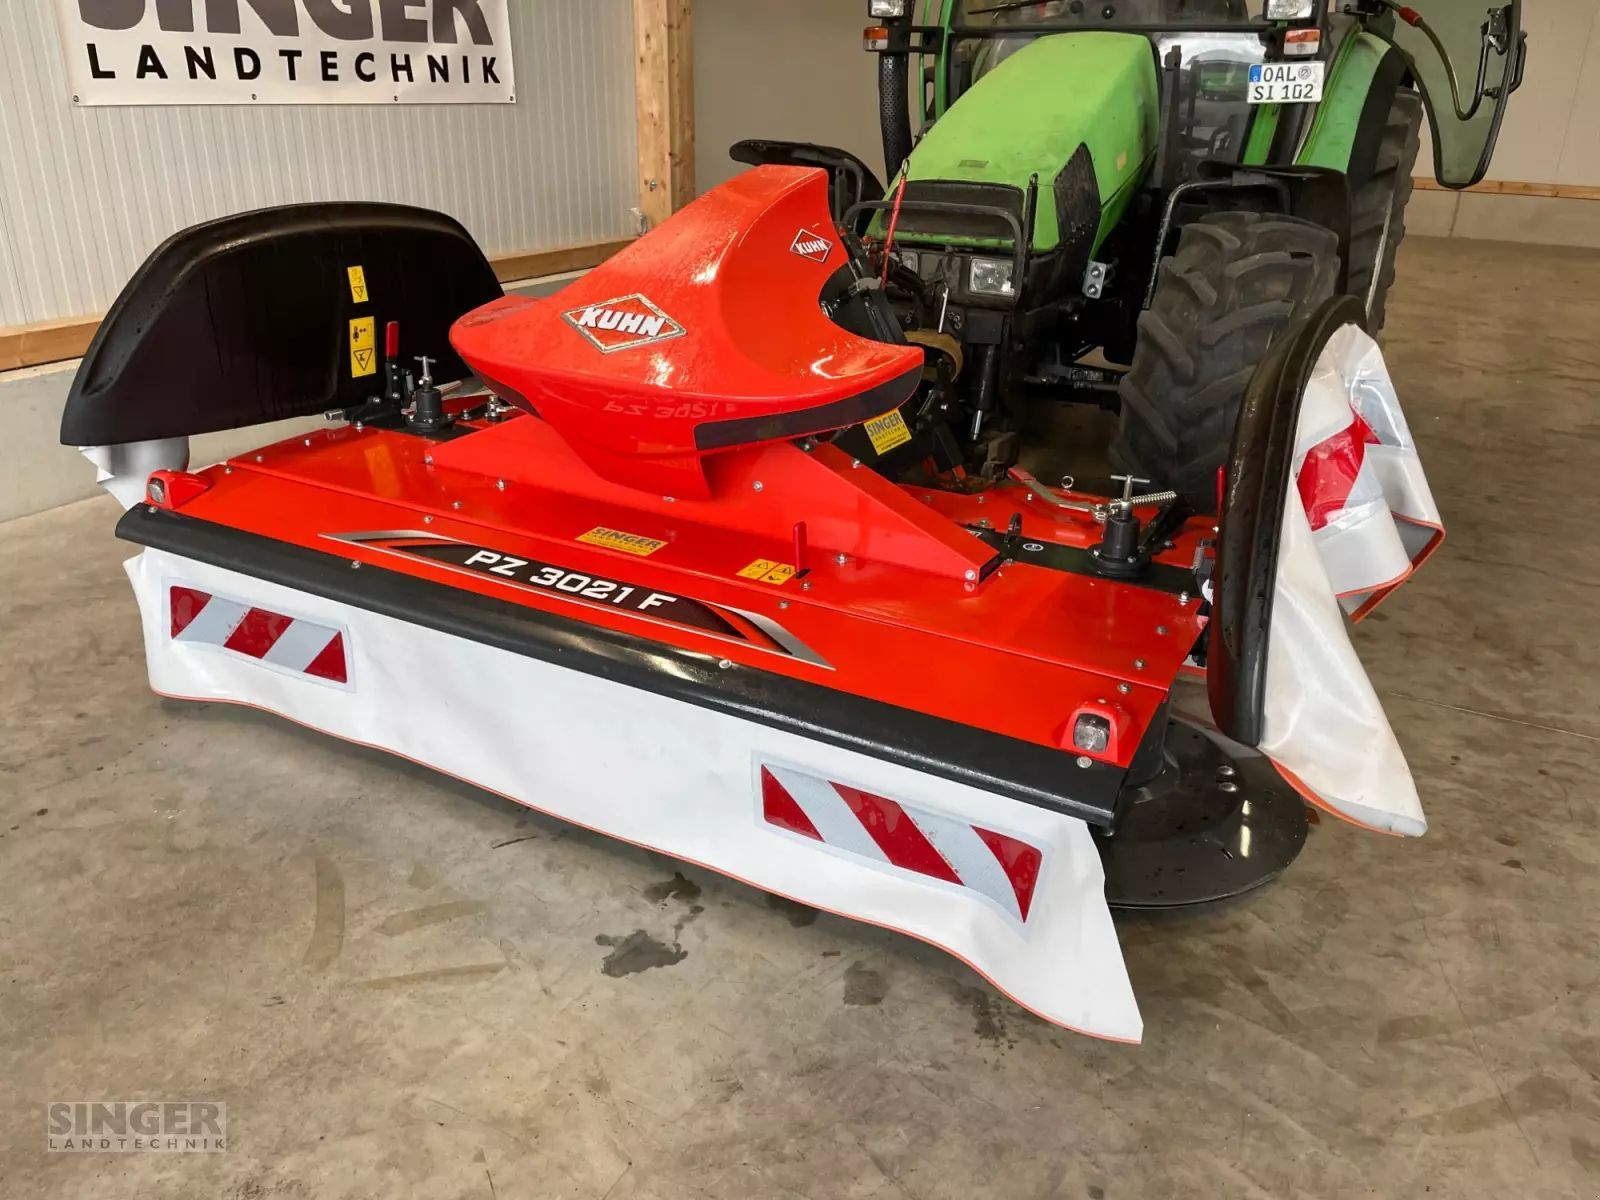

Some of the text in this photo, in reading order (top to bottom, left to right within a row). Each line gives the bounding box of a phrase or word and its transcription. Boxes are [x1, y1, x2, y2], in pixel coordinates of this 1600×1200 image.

[86, 43, 501, 84] LANDTECHNIK
[1263, 66, 1296, 82] OAL
[1253, 83, 1314, 100] SI 102
[795, 239, 829, 255] KUHN
[577, 306, 667, 337] KUHN
[866, 413, 903, 437] SINGER
[593, 528, 661, 548] SINGER
[464, 550, 677, 610] PZ 3021 F
